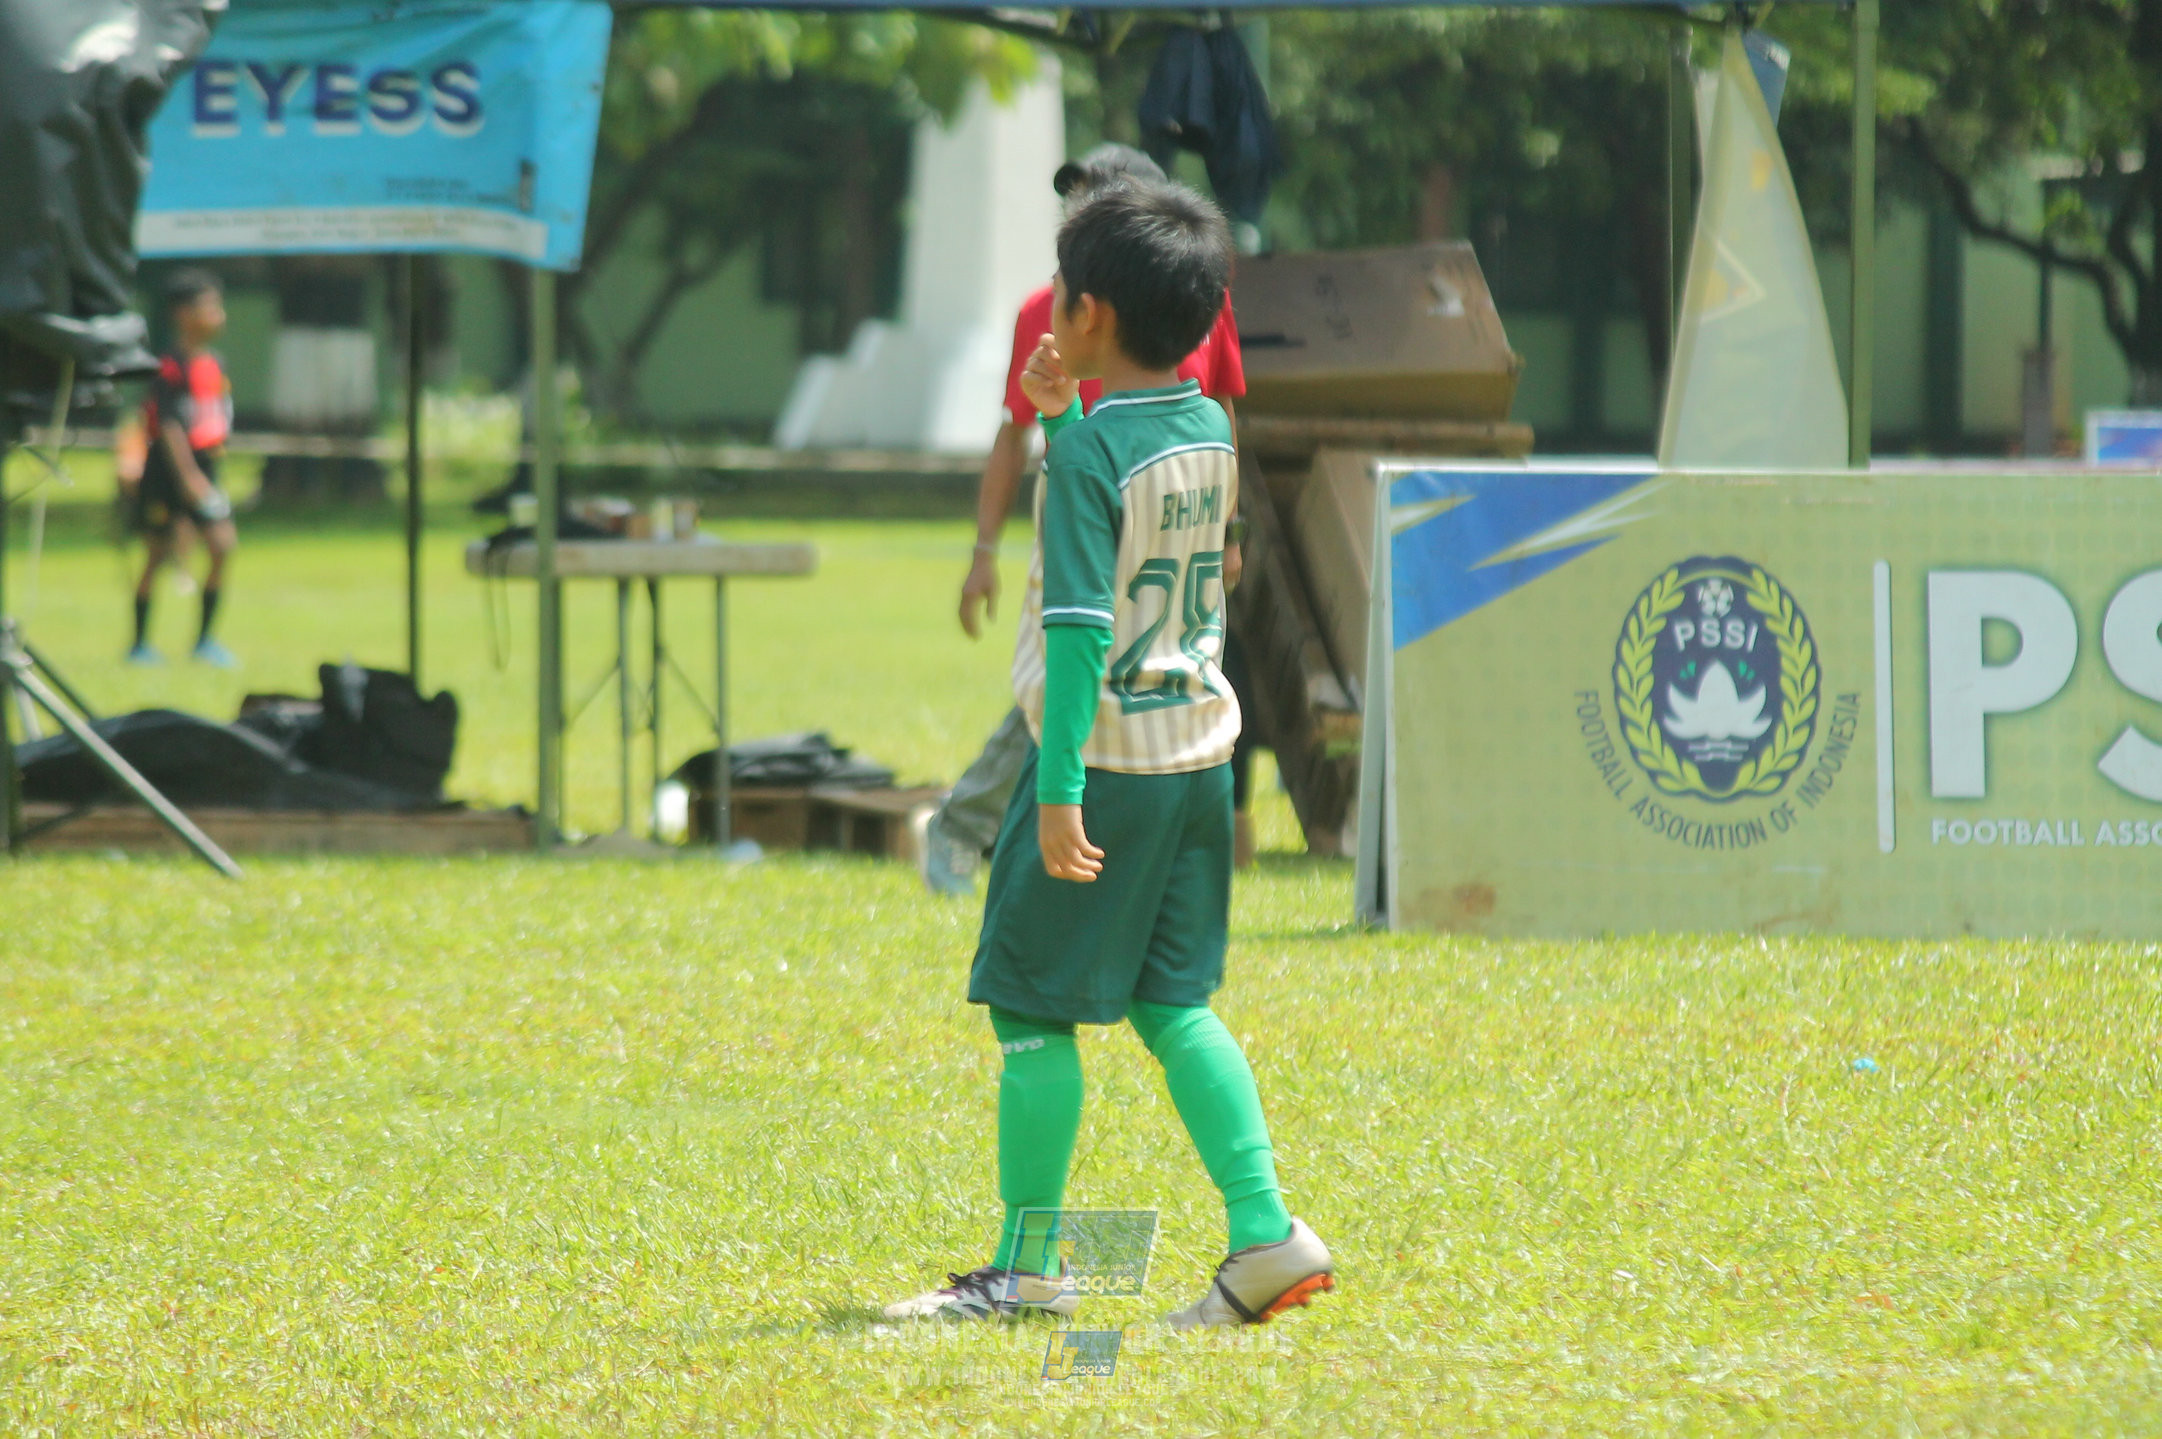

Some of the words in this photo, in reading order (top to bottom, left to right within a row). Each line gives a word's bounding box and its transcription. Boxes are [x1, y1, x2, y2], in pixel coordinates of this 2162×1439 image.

[1161, 485, 1222, 530] BHUMI
[1673, 617, 1758, 653] PSSI
[1574, 690, 1633, 800] FOOTBALL
[1629, 795, 1768, 850] ASSOCIATION
[1770, 800, 1798, 834] OF
[1796, 691, 1861, 809] INDONESIA
[1931, 818, 2085, 846] FOOTBALL
